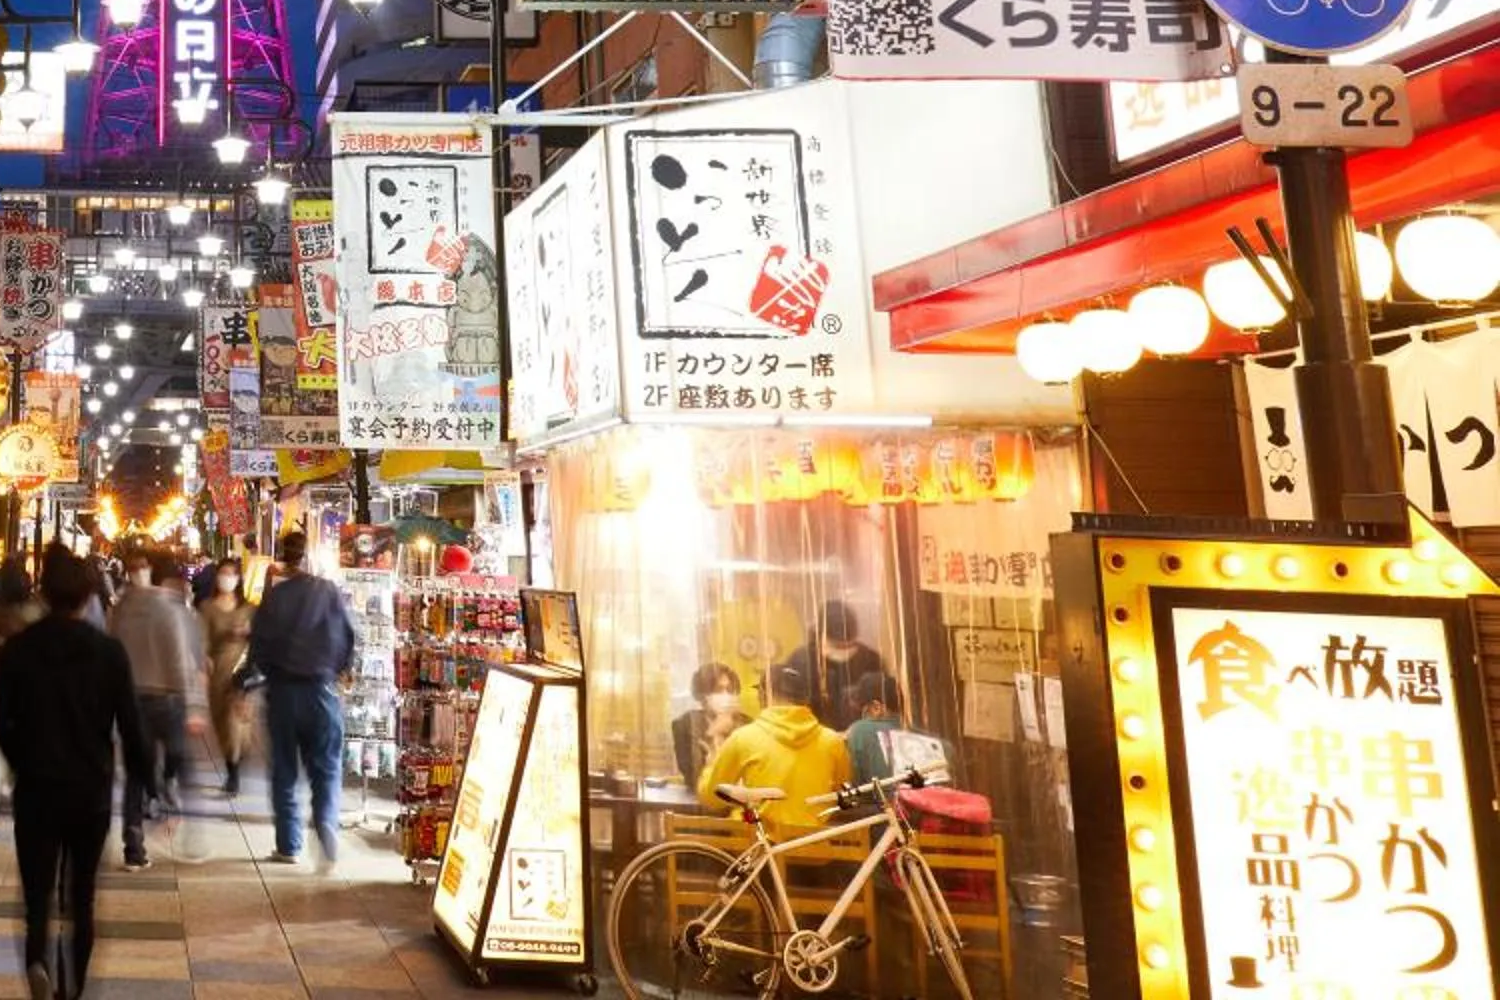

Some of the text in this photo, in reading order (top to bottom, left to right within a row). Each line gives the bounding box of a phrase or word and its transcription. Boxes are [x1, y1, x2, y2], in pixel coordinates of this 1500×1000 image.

[1251, 85, 1399, 128] 9-22
[643, 353, 836, 378] 1F カウンター席
[643, 385, 838, 412] 2F 座敷あります
[348, 416, 495, 441] 宴会予約受付中
[1187, 619, 1444, 722] 食べ放題
[1288, 723, 1362, 904] 串かつ
[1359, 729, 1459, 975] 串かつ
